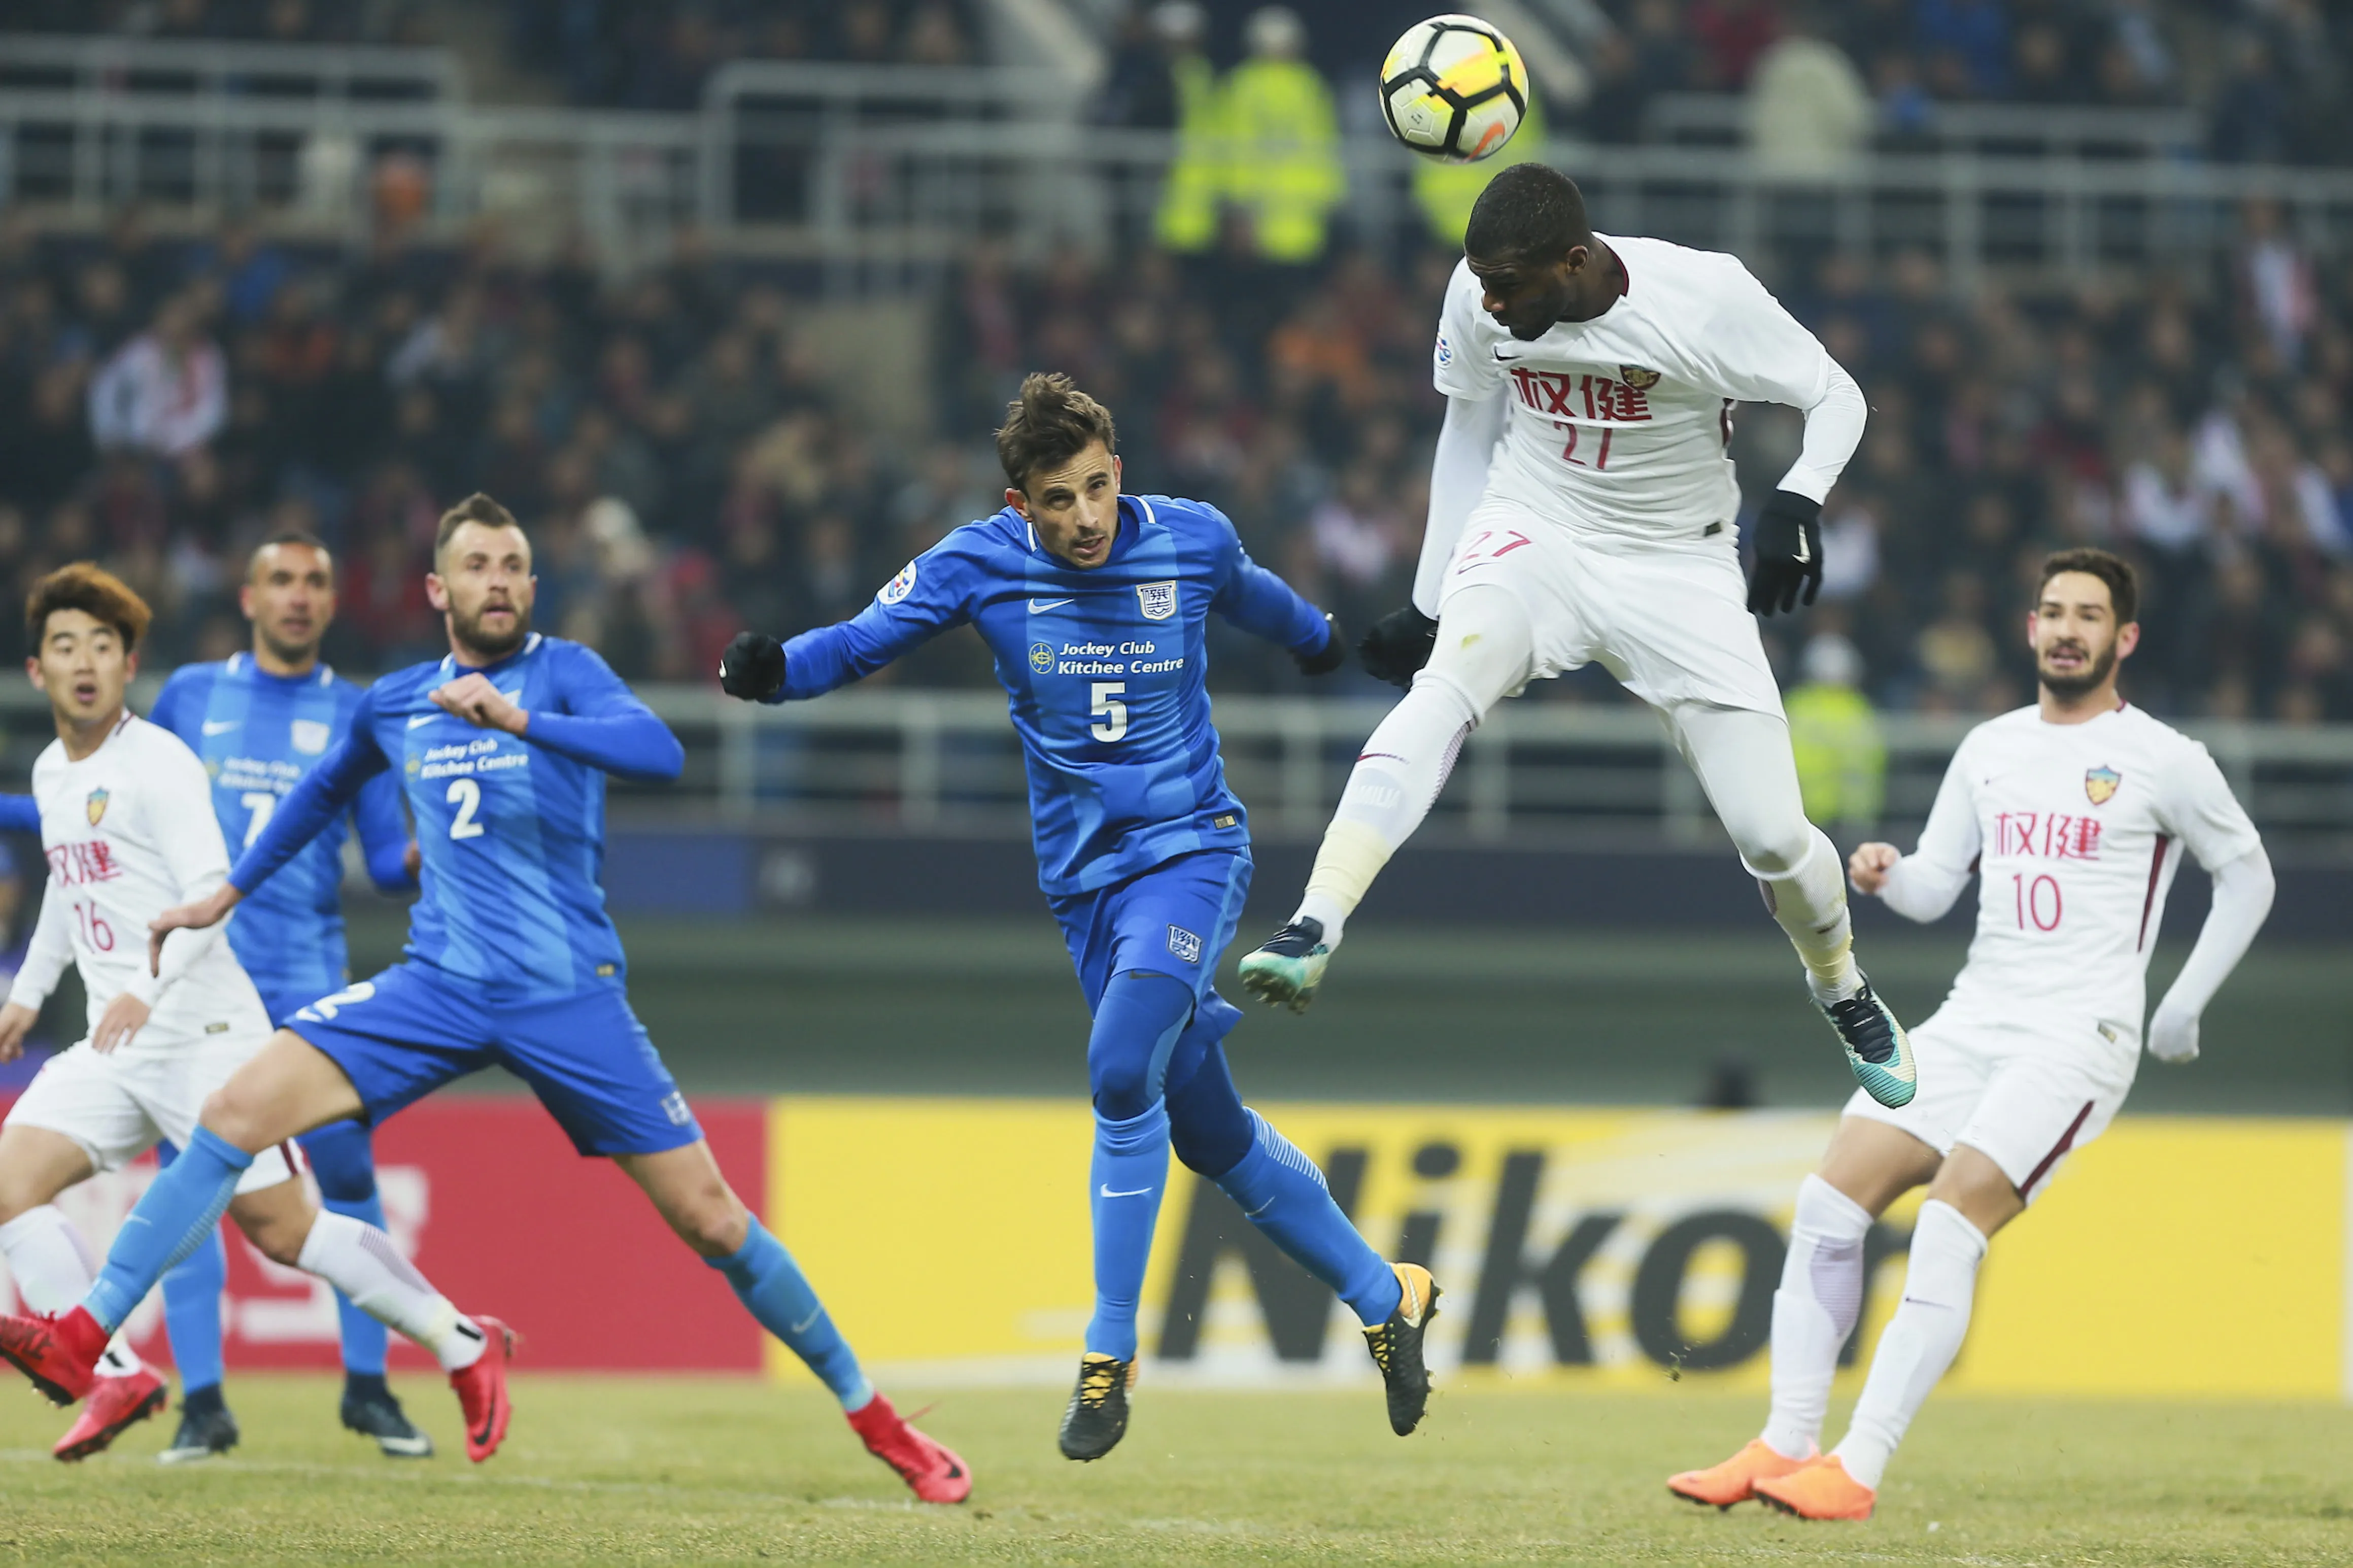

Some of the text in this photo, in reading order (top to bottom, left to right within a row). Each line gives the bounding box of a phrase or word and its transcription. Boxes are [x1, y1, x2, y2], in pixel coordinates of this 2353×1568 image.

[1510, 367, 1652, 421] 权健
[1554, 421, 1613, 469] 27
[1458, 531, 1531, 560] 27
[1058, 658, 1184, 674] Kitchee Centre
[1060, 640, 1155, 658] Jockey Club
[1091, 682, 1127, 742] 5
[241, 793, 275, 849] 7
[446, 778, 484, 840] 2
[1995, 812, 2102, 861] 权健
[75, 901, 114, 954] 16
[2014, 873, 2062, 932] 10
